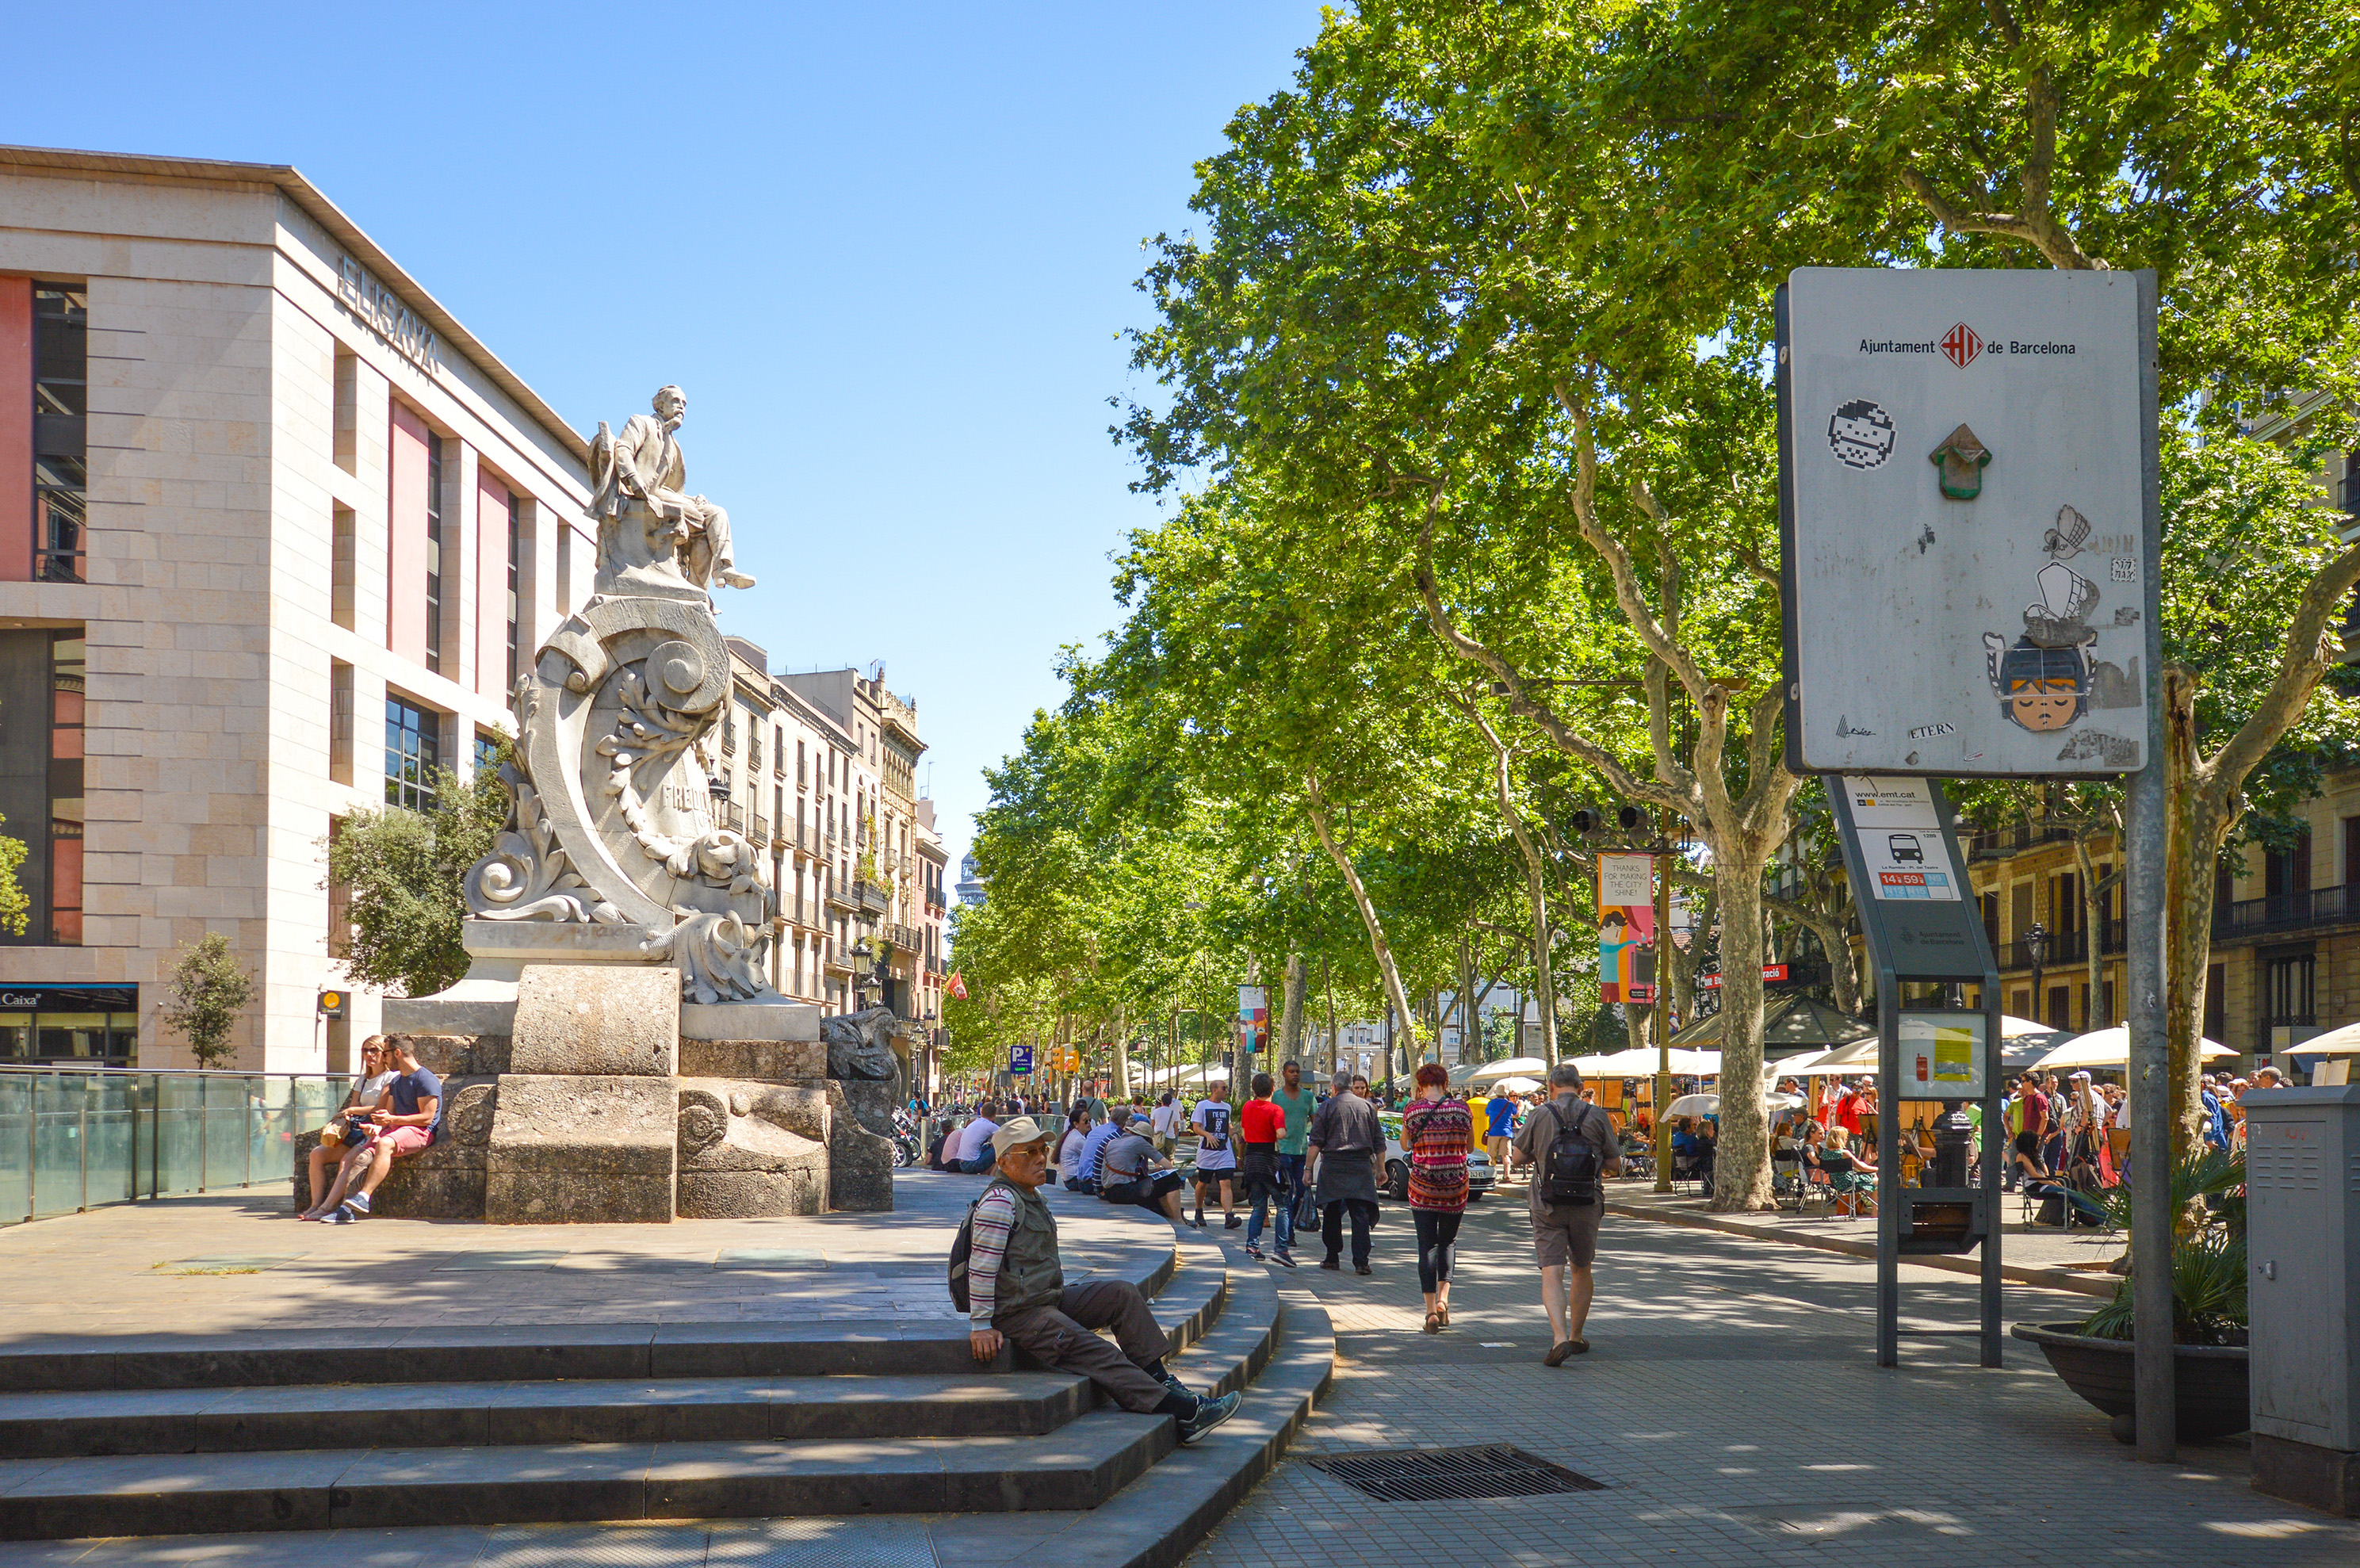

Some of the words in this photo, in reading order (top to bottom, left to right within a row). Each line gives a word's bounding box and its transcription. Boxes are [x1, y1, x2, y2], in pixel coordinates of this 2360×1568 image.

[342, 254, 438, 365] ELISAVA
[1859, 338, 1935, 354] Ajuntament
[1987, 341, 2003, 354] de
[2010, 341, 2075, 354] Barcelona
[1911, 722, 1956, 740] ETERN
[1903, 875, 1918, 884] 59
[1763, 968, 1780, 978] ració
[1012, 1047, 1023, 1061] P
